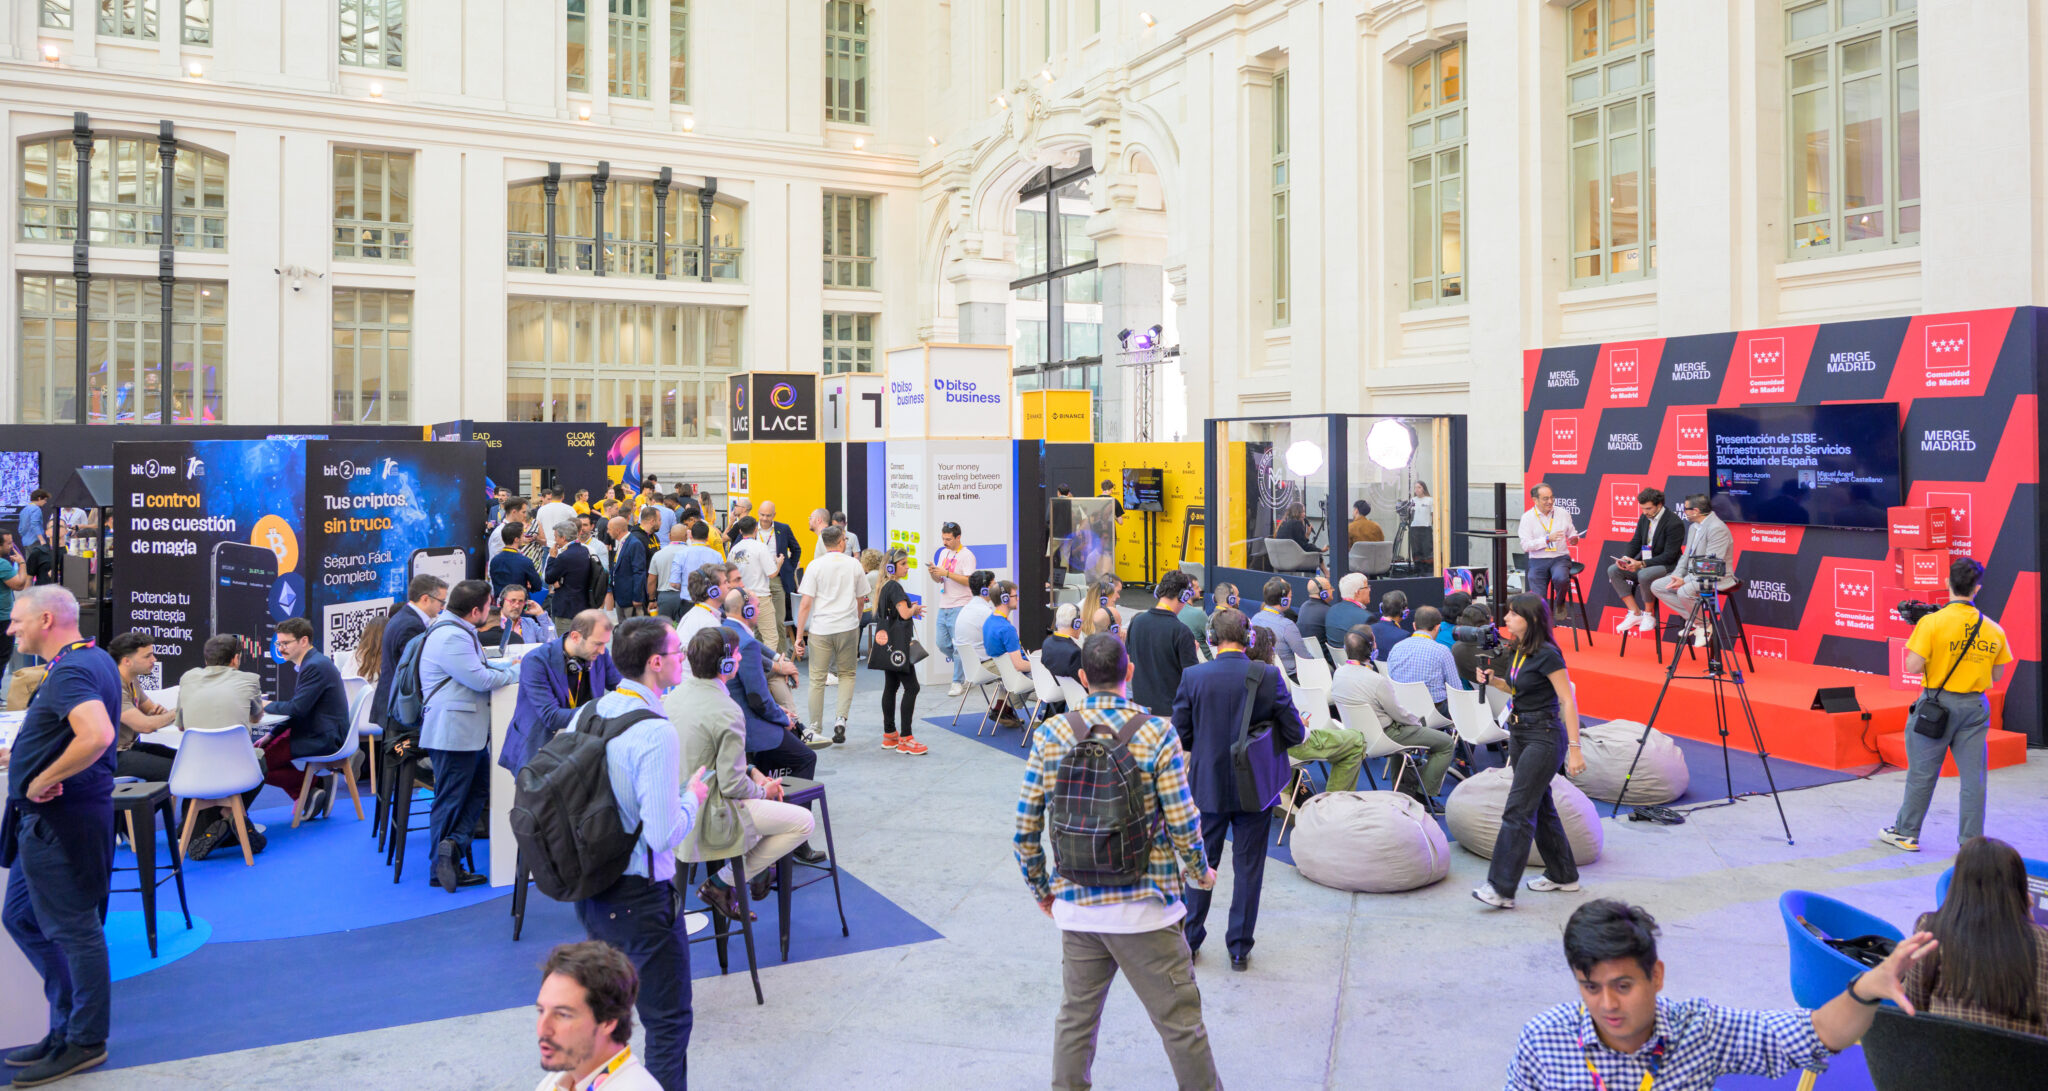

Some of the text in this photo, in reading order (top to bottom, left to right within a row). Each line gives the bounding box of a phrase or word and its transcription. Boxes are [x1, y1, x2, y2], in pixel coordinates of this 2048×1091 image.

[1830, 352, 1870, 362] MERGE
[1674, 362, 1707, 372] MERGE
[1827, 362, 1876, 372] MADRID
[1550, 370, 1576, 379] MERGE
[1672, 371, 1710, 380] MADRID
[1926, 370, 1970, 378] Comunidad
[897, 381, 912, 392] bitso
[946, 380, 976, 391] bitso
[1548, 378, 1579, 387] MADRID
[1938, 377, 1970, 386] Madrid
[897, 393, 924, 406] business
[946, 392, 1000, 404] business
[733, 416, 748, 432] LACE
[761, 416, 808, 431] LACE
[1610, 434, 1638, 442] MERGE
[1716, 434, 1776, 444] Presentación
[1777, 434, 1790, 444] de
[1791, 433, 1817, 443] ISBE
[1924, 430, 1970, 441] MERGE
[1608, 442, 1642, 450] MADRID
[1716, 444, 1851, 455] Infraestructura de Servicios
[1921, 441, 1976, 451] MADRID
[1716, 456, 1818, 468] Blockchain de España
[130, 459, 176, 478] bit2me
[324, 460, 371, 479] bit2me
[978, 483, 1002, 491] Europe
[132, 493, 200, 508] El control
[324, 492, 408, 510] Tus criptos.
[131, 515, 236, 532] no es cuestión
[324, 518, 394, 534] sin truco.
[131, 539, 197, 557] de magia
[324, 554, 366, 569] Seguro.
[324, 570, 376, 586] Completo
[1750, 580, 1786, 593] MERGE
[131, 592, 190, 605] Potencia tu
[1748, 589, 1791, 602] MADRID
[131, 610, 186, 624] estrategia
[1835, 612, 1874, 621] Comunidad
[1847, 620, 1874, 630] Madrid
[152, 626, 192, 641] Trading
[1950, 640, 1997, 653] MERGE
